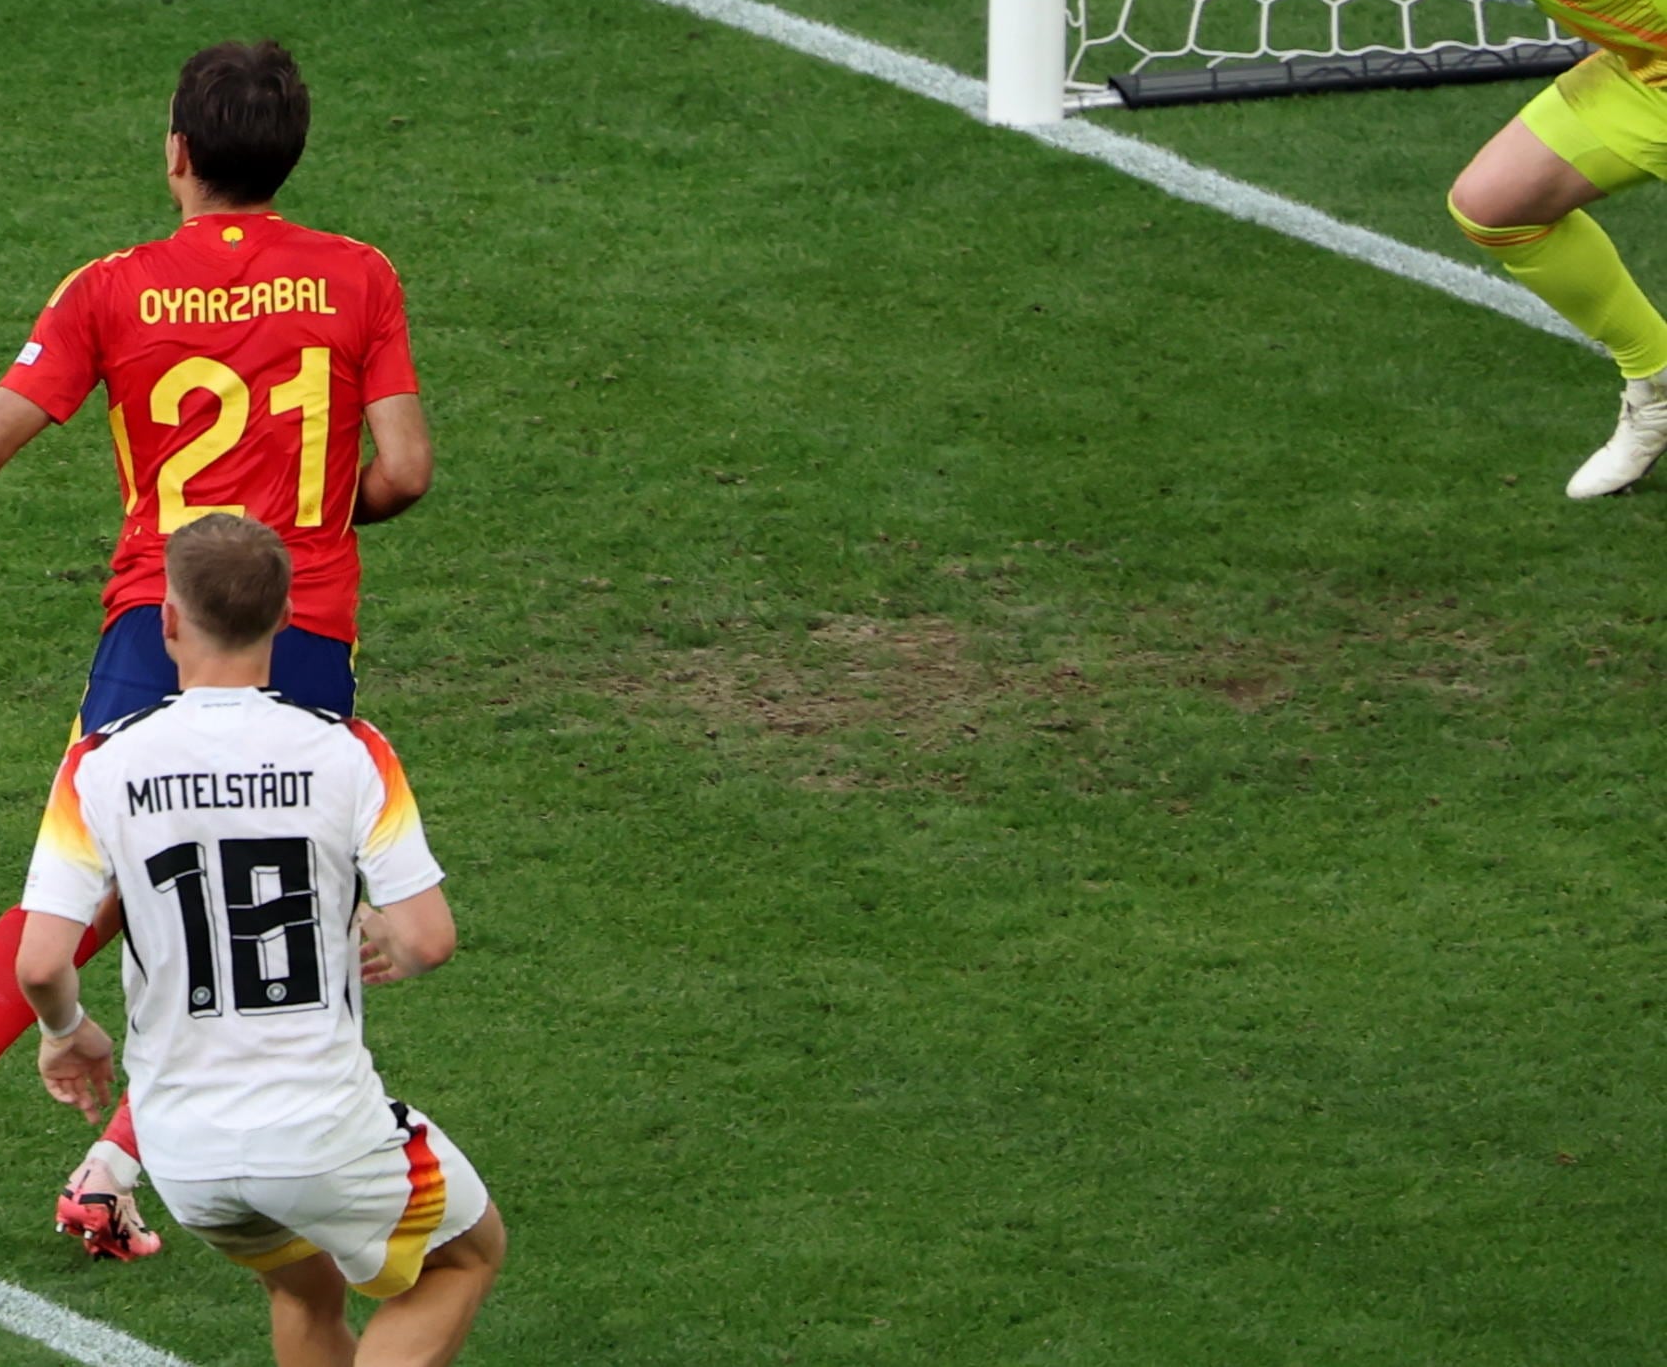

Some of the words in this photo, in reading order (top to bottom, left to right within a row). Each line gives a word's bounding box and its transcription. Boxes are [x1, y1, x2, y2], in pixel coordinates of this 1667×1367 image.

[140, 277, 336, 324] OYARZABAL
[150, 347, 331, 534] 21
[126, 763, 314, 817] MITTELSTÄDT
[145, 837, 328, 1020] 18
